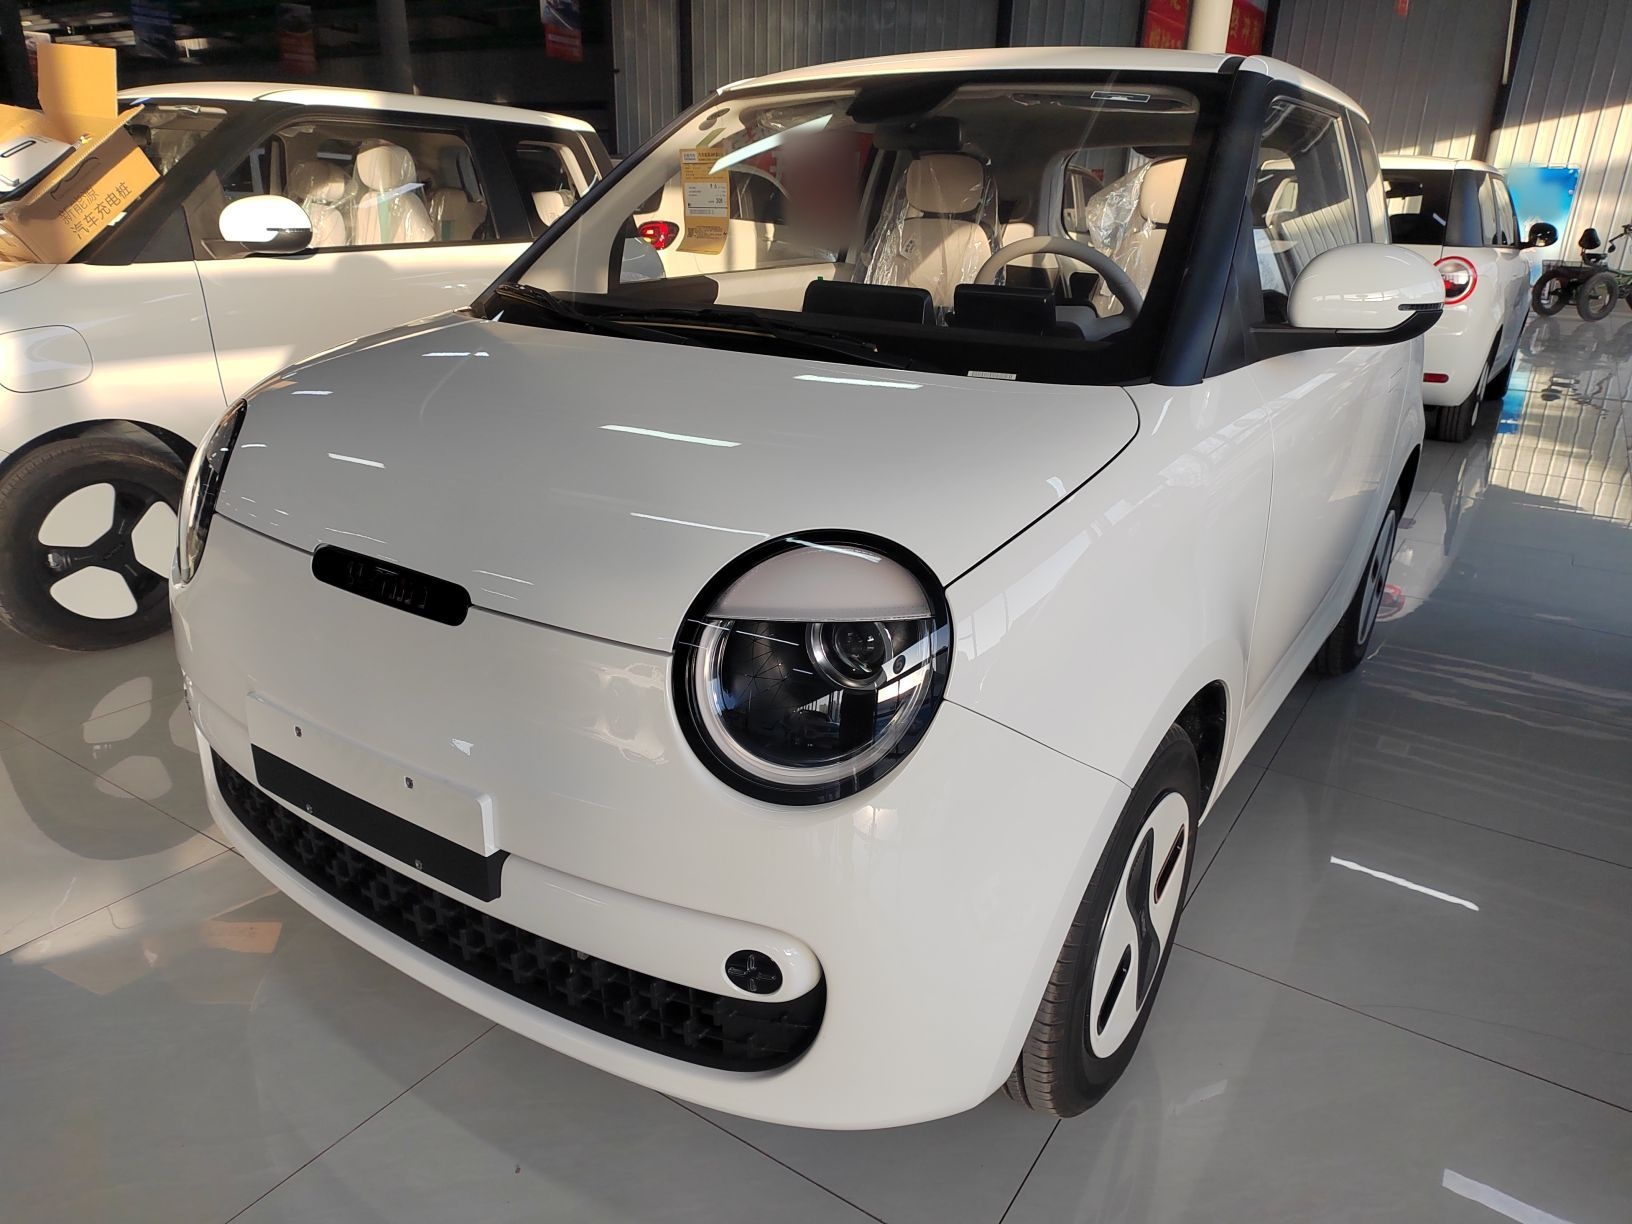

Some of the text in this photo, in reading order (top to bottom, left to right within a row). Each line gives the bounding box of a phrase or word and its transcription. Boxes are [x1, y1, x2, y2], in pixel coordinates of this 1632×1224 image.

[58, 185, 100, 225] 新能源
[70, 181, 133, 240] 汽车充电桩
